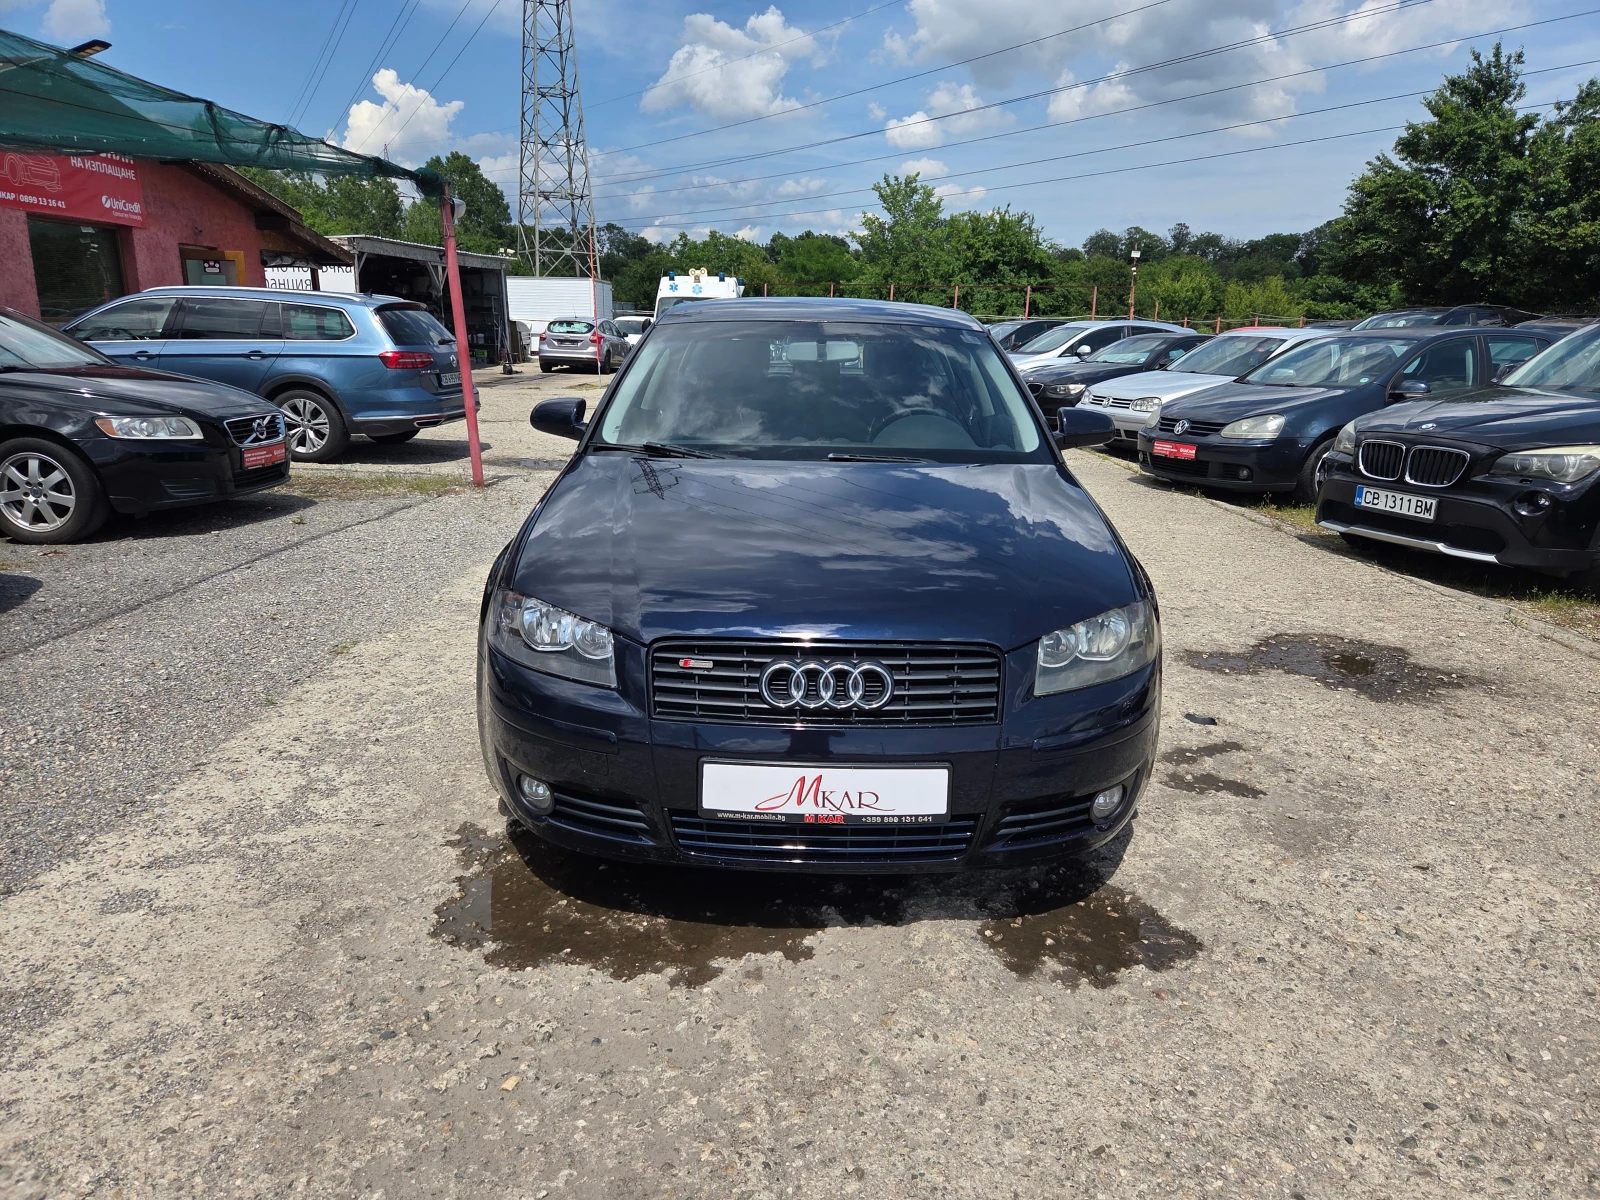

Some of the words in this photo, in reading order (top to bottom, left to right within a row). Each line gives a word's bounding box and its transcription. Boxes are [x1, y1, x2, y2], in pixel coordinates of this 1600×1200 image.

[71, 156, 83, 169] НА
[84, 159, 136, 180] ИЗПЛАЩАНЕ
[20, 194, 37, 204] 0899
[39, 197, 47, 206] 13
[48, 199, 57, 207] 16
[57, 200, 66, 209] 41
[717, 811, 786, 822] www.m-kar.mobile.bg
[804, 814, 815, 824] M
[818, 815, 845, 824] KAR
[901, 815, 915, 823] 131
